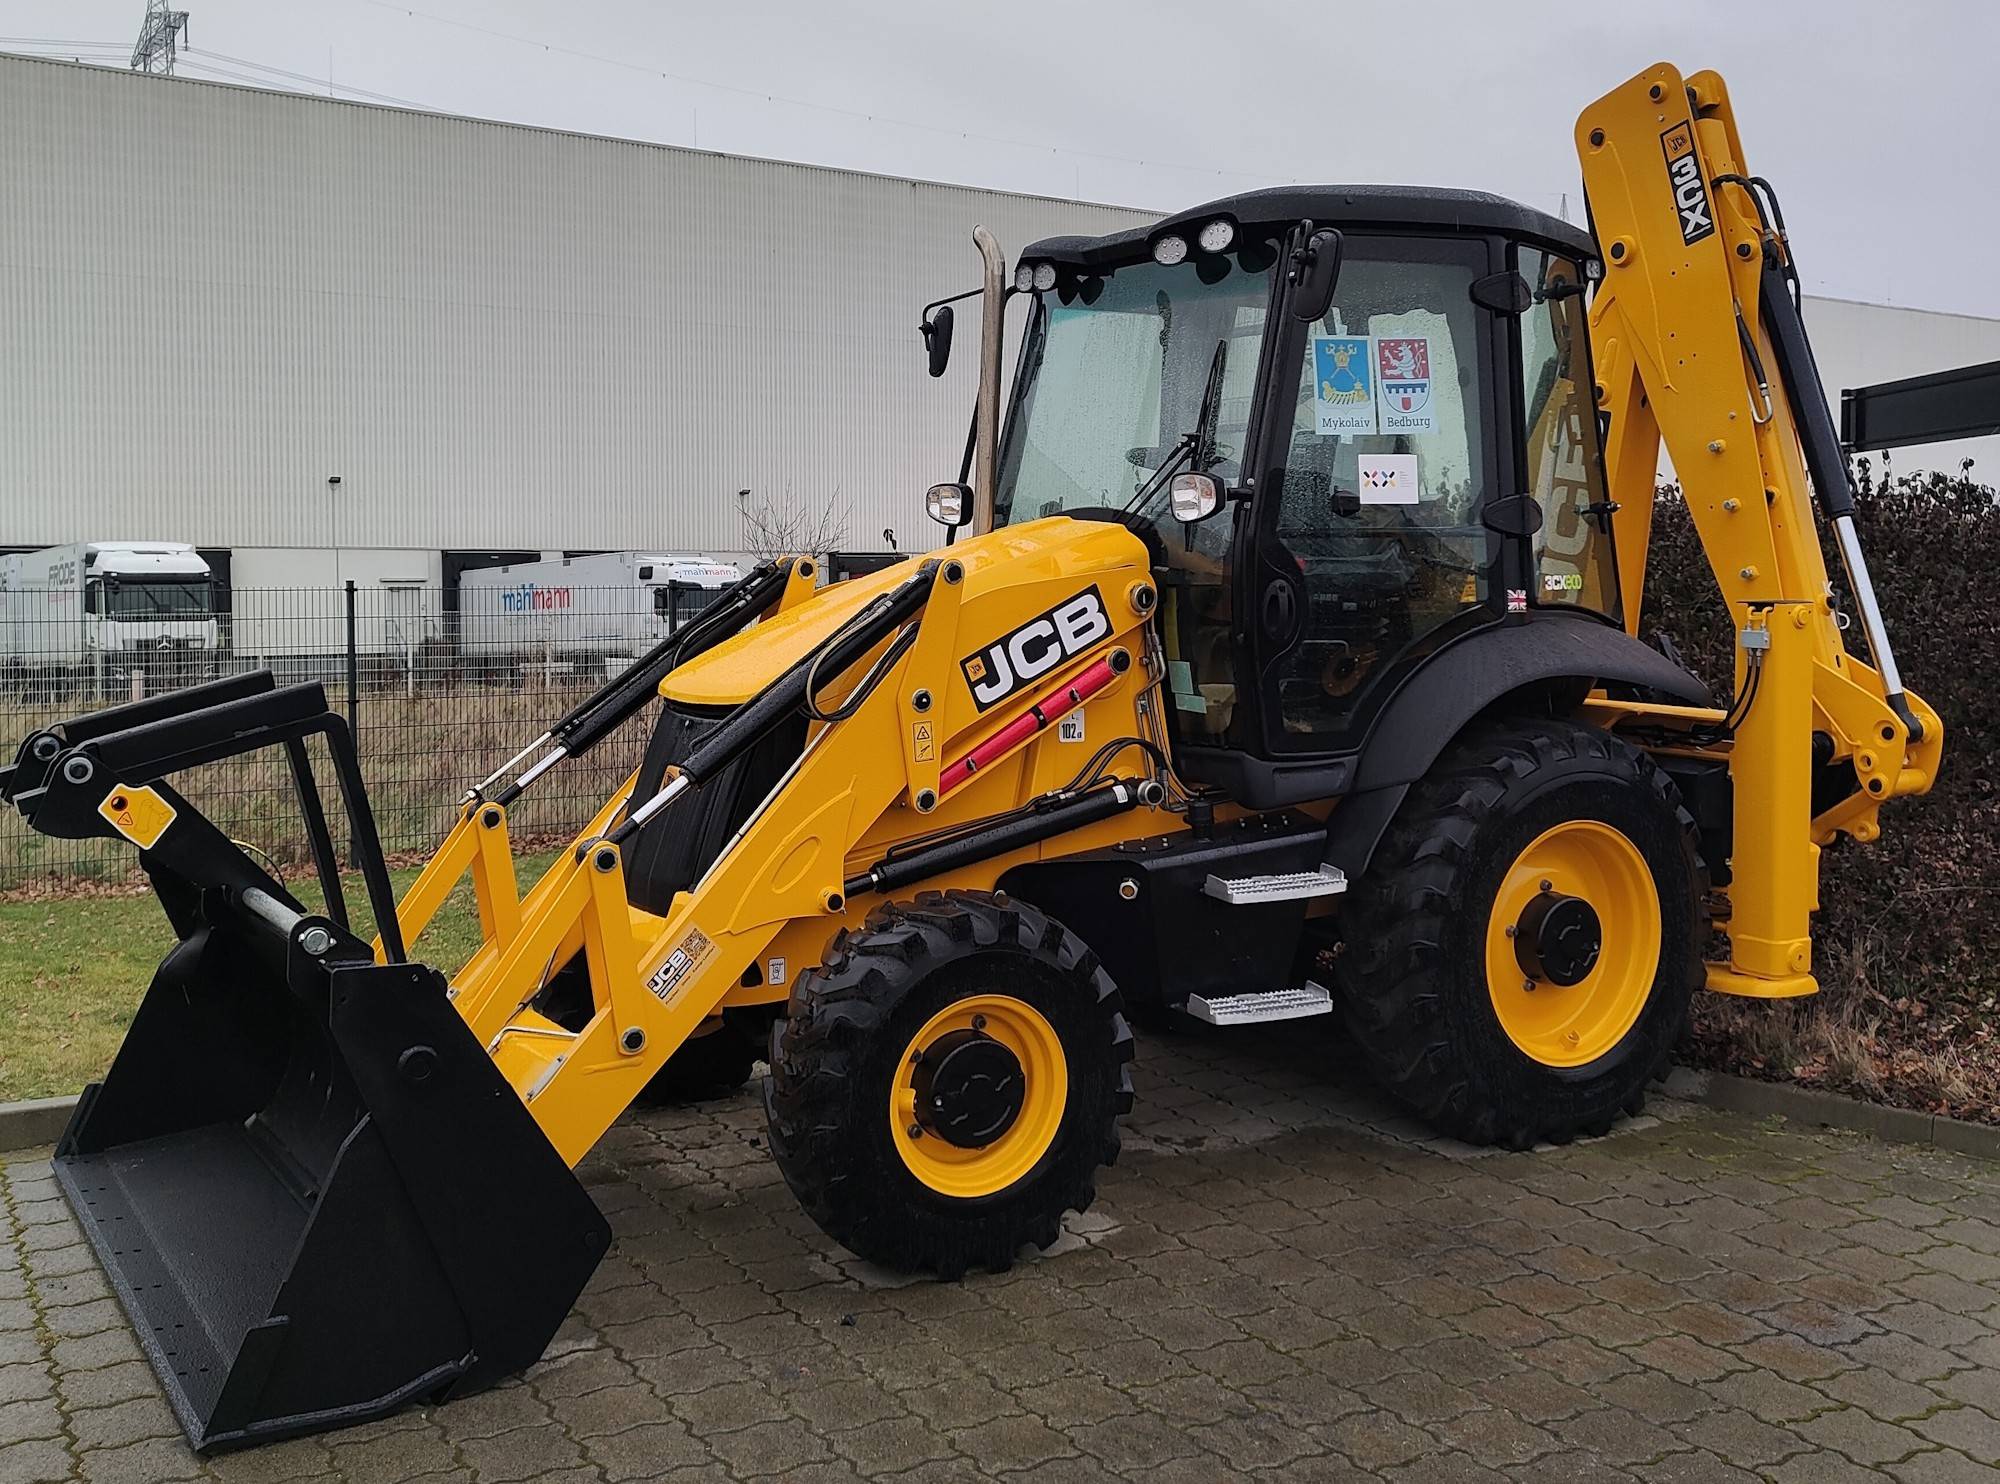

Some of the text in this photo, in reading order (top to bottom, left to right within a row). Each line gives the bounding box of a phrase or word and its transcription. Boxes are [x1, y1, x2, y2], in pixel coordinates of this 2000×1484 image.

[1671, 155, 1712, 235] 3CX
[1322, 417, 1370, 430] Mykolaiv
[1387, 416, 1431, 429] Bedburg
[683, 568, 731, 576] mahlmann
[502, 583, 570, 611] mahlmann
[974, 594, 1107, 703] JCB
[1062, 723, 1077, 739] 102
[652, 949, 687, 993] JCB
